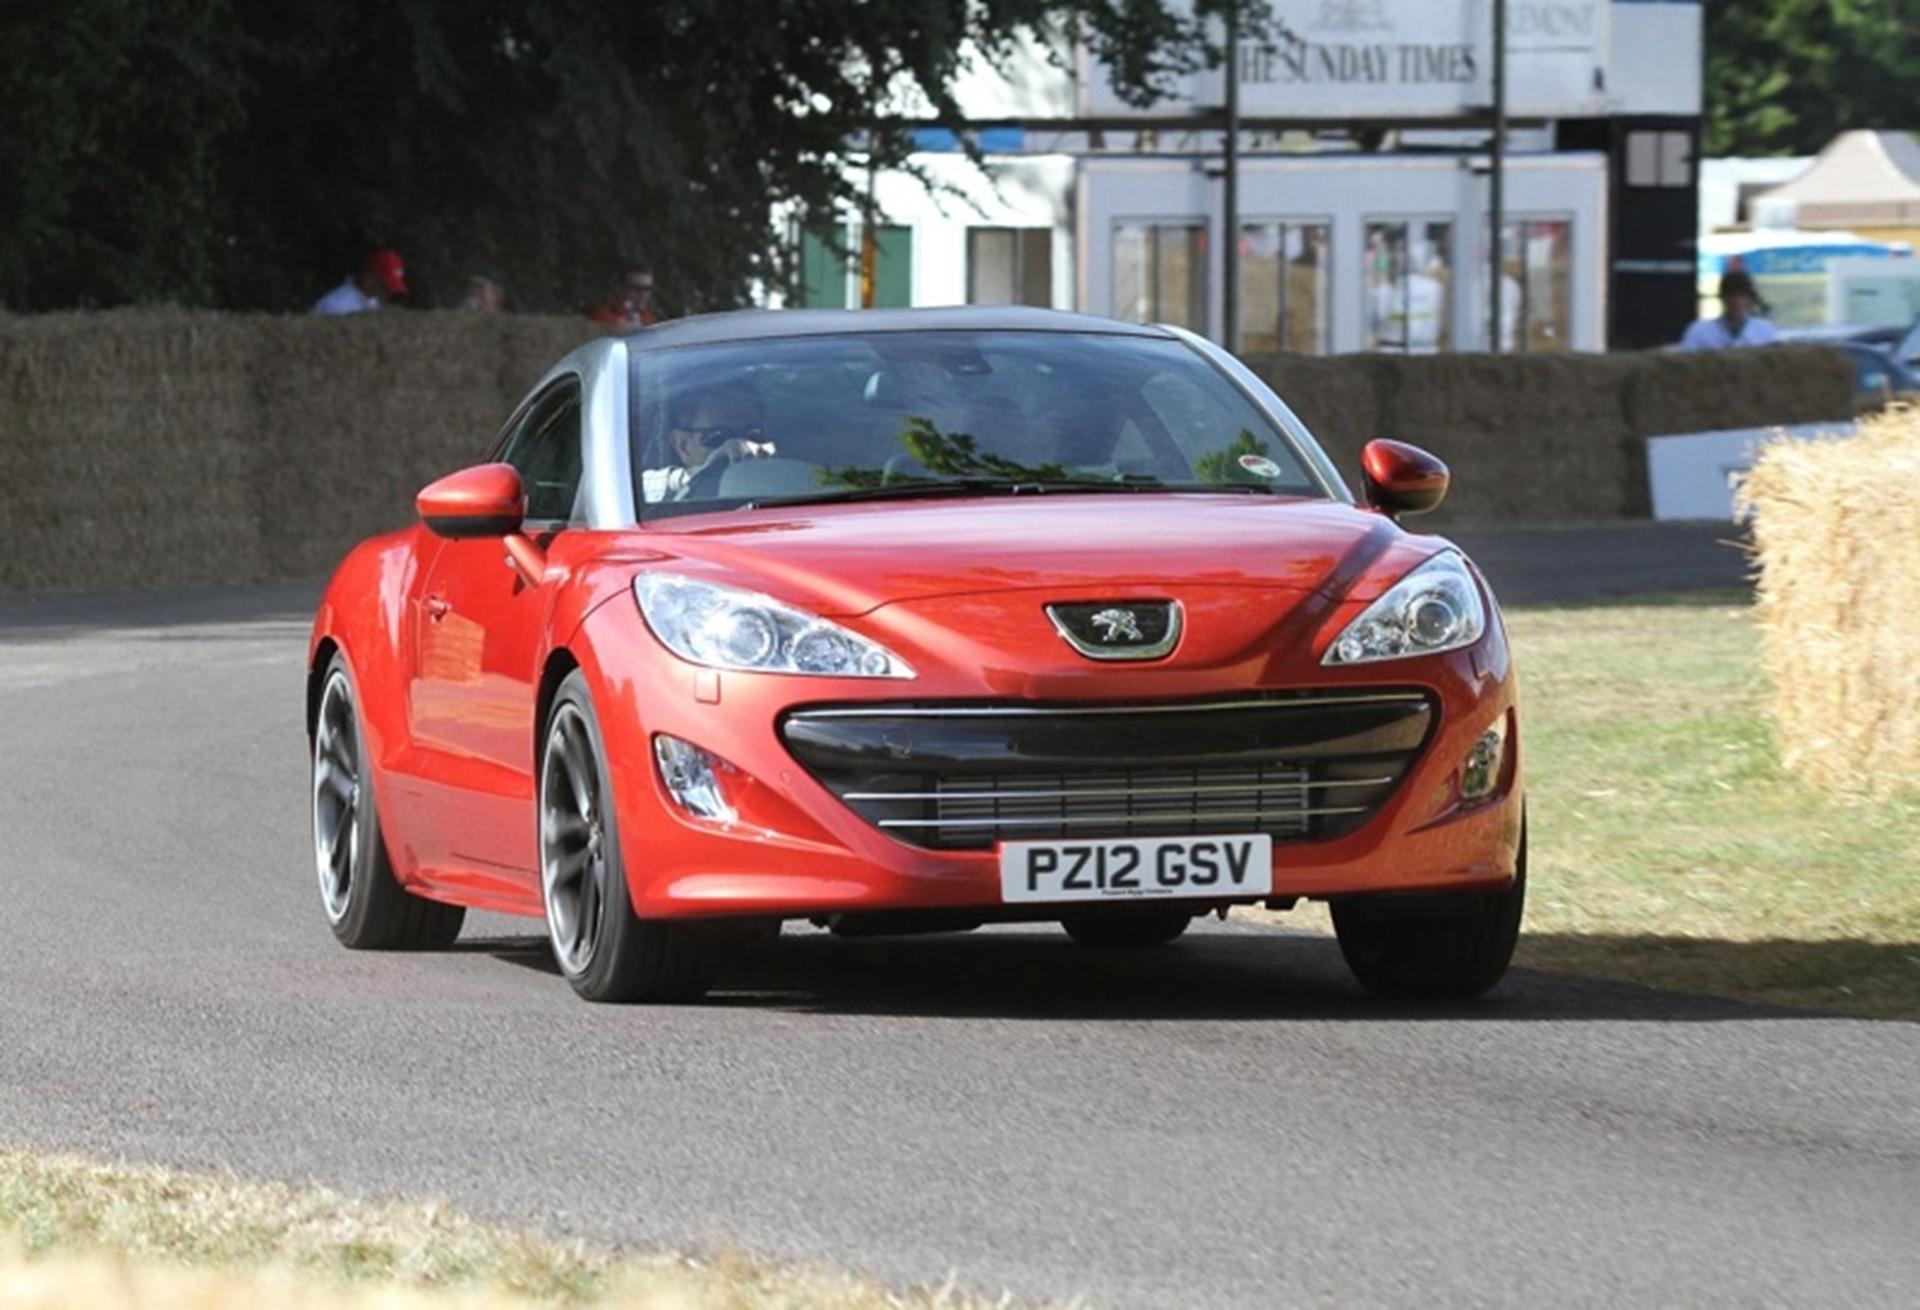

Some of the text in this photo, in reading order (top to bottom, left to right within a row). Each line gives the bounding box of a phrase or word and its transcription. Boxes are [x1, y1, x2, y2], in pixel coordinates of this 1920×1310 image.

[1239, 43, 1477, 84] HE SUNDAY TIMES
[1027, 842, 1252, 890] PZ12 GSV
